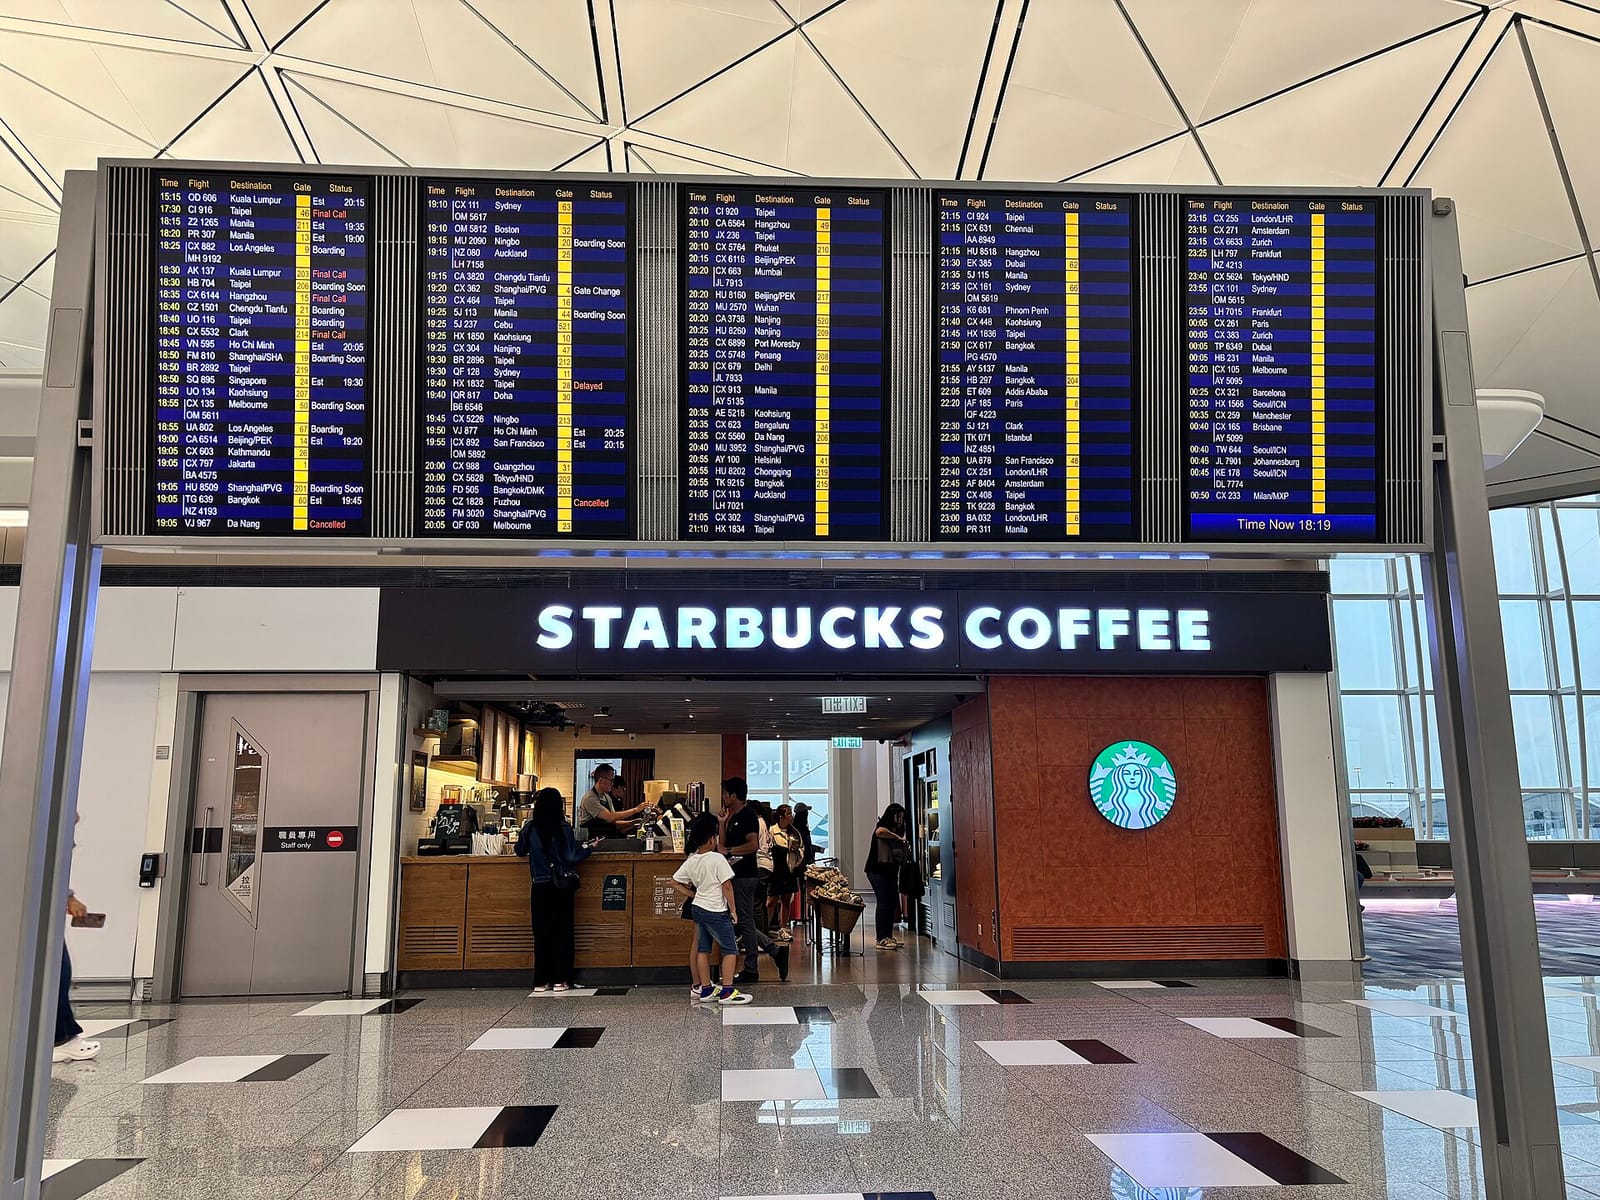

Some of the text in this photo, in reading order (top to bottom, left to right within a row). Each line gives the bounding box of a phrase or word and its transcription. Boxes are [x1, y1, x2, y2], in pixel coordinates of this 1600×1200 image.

[160, 179, 178, 187] Time
[189, 180, 209, 189] Flight
[294, 183, 311, 191] Gate
[330, 184, 352, 192] Status
[456, 187, 474, 197] Flight
[188, 193, 201, 201] OD
[313, 197, 325, 205] Est
[716, 194, 735, 203] Flight
[967, 199, 985, 208] Flight
[1214, 201, 1232, 210] Flight
[161, 205, 180, 213] 17:30
[188, 205, 196, 213] CI
[230, 207, 252, 215] Taipei
[313, 209, 330, 217] Final
[755, 208, 775, 216] Taipei
[161, 217, 180, 225] 18:15
[230, 219, 254, 227] Manila
[1005, 213, 1024, 221] Taipei
[495, 238, 520, 247] Ningbo
[574, 239, 605, 248] Boarding
[187, 303, 198, 311] CZ
[230, 304, 263, 313] Chengdu
[265, 305, 287, 313] Tianfu
[312, 306, 344, 316] Boarding
[689, 338, 708, 346] 20:25
[494, 380, 514, 388] Taipei
[506, 427, 518, 435] Chi
[574, 428, 585, 436] Est
[604, 429, 624, 437] 20:25
[689, 478, 708, 486] 20:55
[755, 479, 784, 488] Bangkok
[240, 520, 260, 529] Nang
[1238, 519, 1330, 530] Time Now 18:19
[536, 606, 1210, 650] STARBUCKS COFFEE
